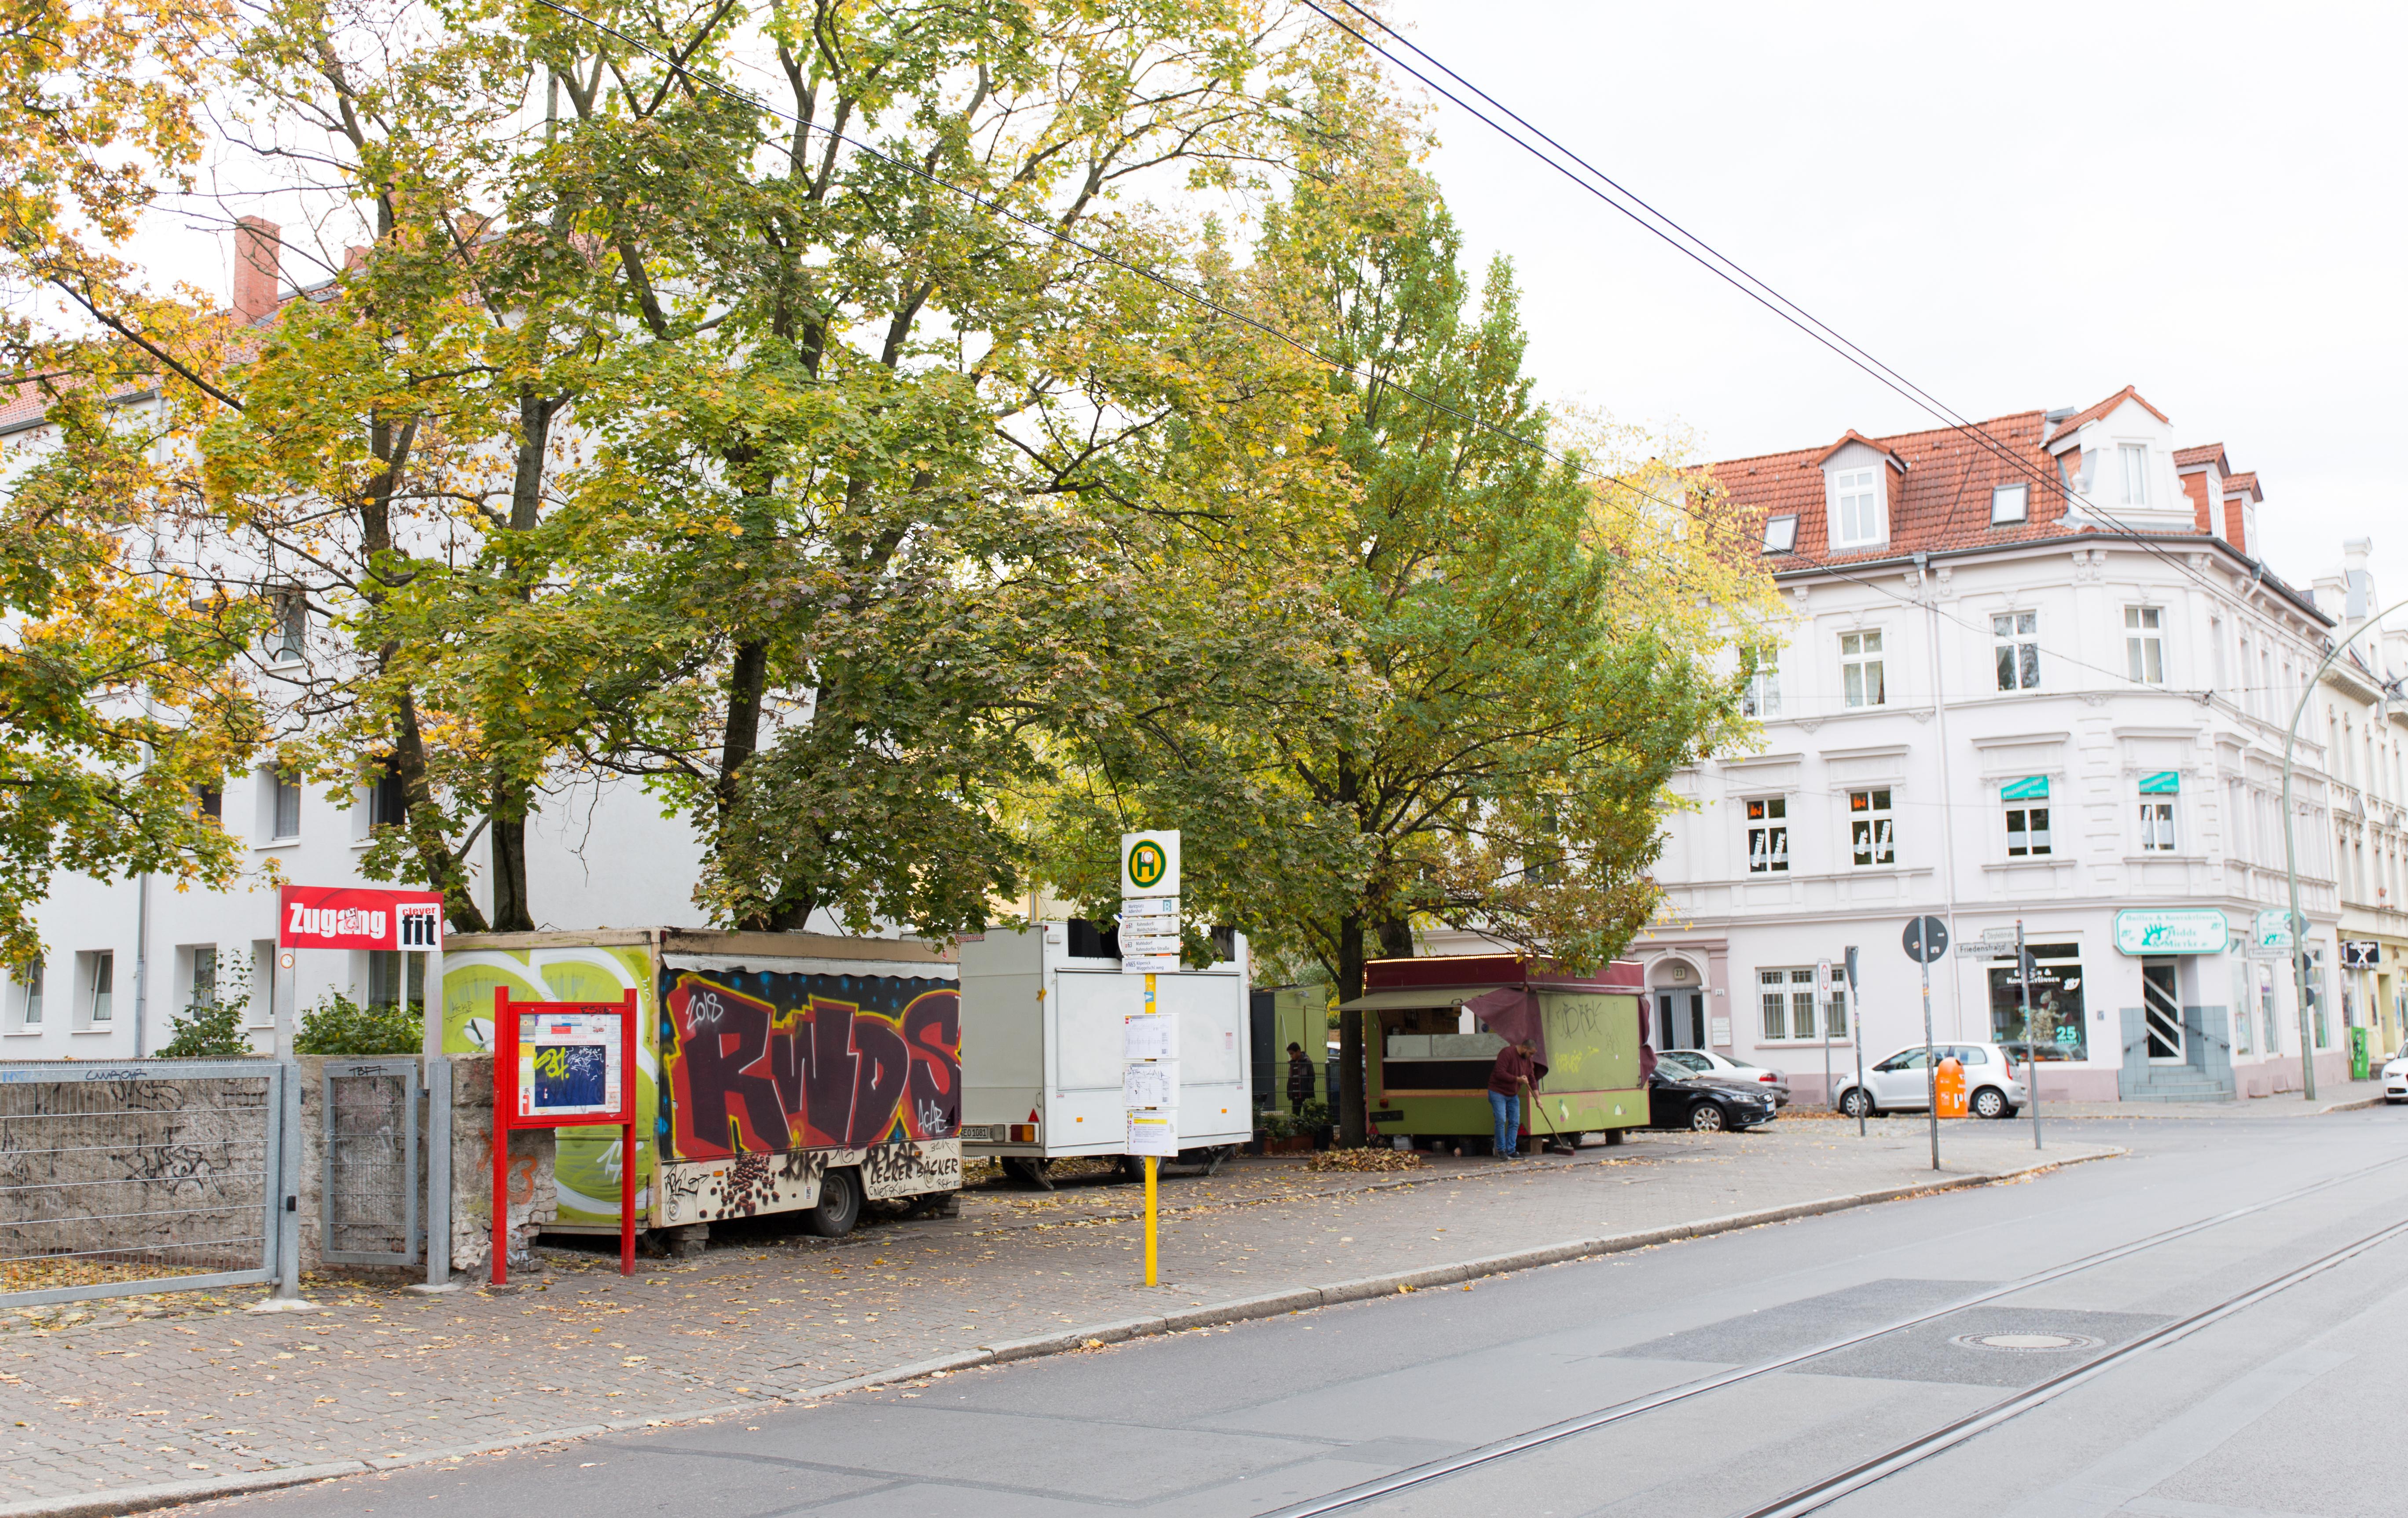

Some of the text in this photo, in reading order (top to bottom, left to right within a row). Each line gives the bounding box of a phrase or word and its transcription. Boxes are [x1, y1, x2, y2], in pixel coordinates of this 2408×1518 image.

[402, 907, 436, 916] clever
[1164, 901, 1171, 912] B
[289, 902, 386, 939] Zugang
[402, 914, 436, 946] fit
[686, 991, 724, 1030] 2018
[2056, 1026, 2077, 1040] 25
[972, 1128, 987, 1137] 1081
[870, 1155, 958, 1185] LECKER BÄCKER
